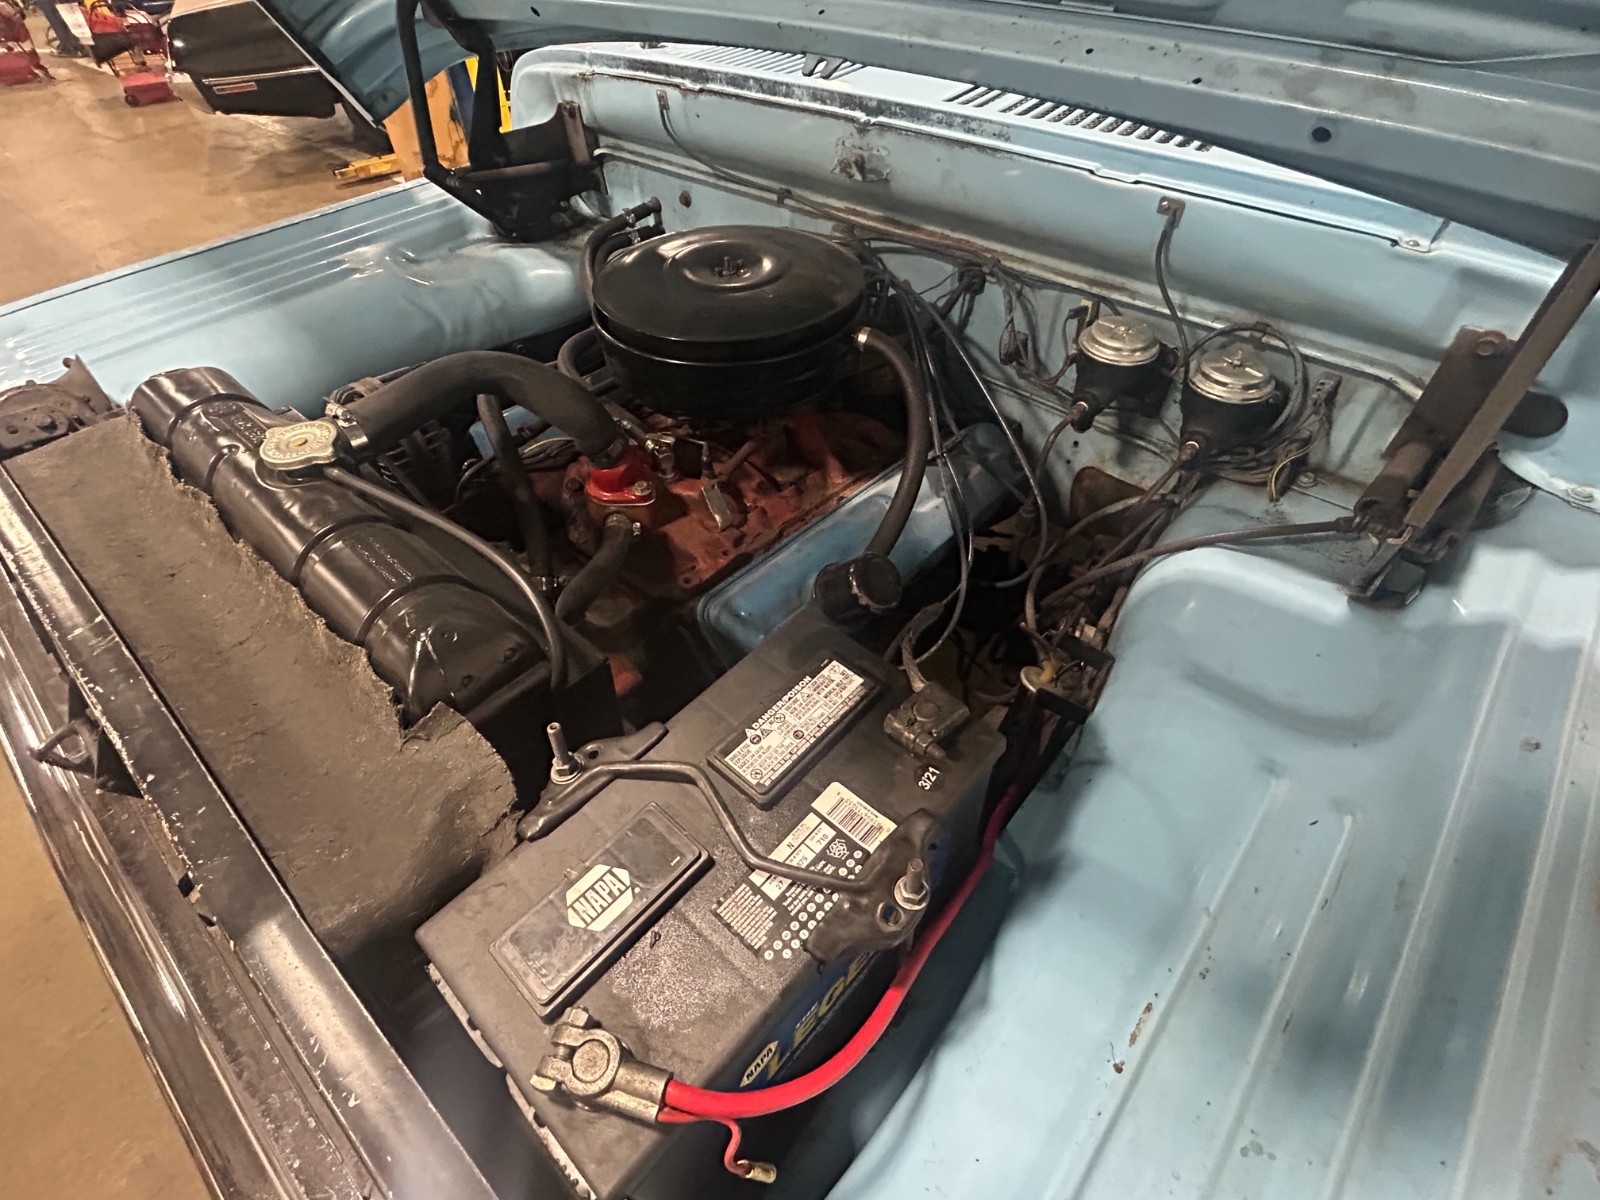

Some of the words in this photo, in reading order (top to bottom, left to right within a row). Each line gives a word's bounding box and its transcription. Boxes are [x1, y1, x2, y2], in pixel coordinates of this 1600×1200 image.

[751, 675, 812, 729] DANGER/POISON
[918, 766, 940, 790] 3/21
[816, 833, 828, 845] 710
[572, 872, 627, 924] NAPA
[774, 879, 785, 890] 27
[745, 1047, 773, 1081] NAPA
